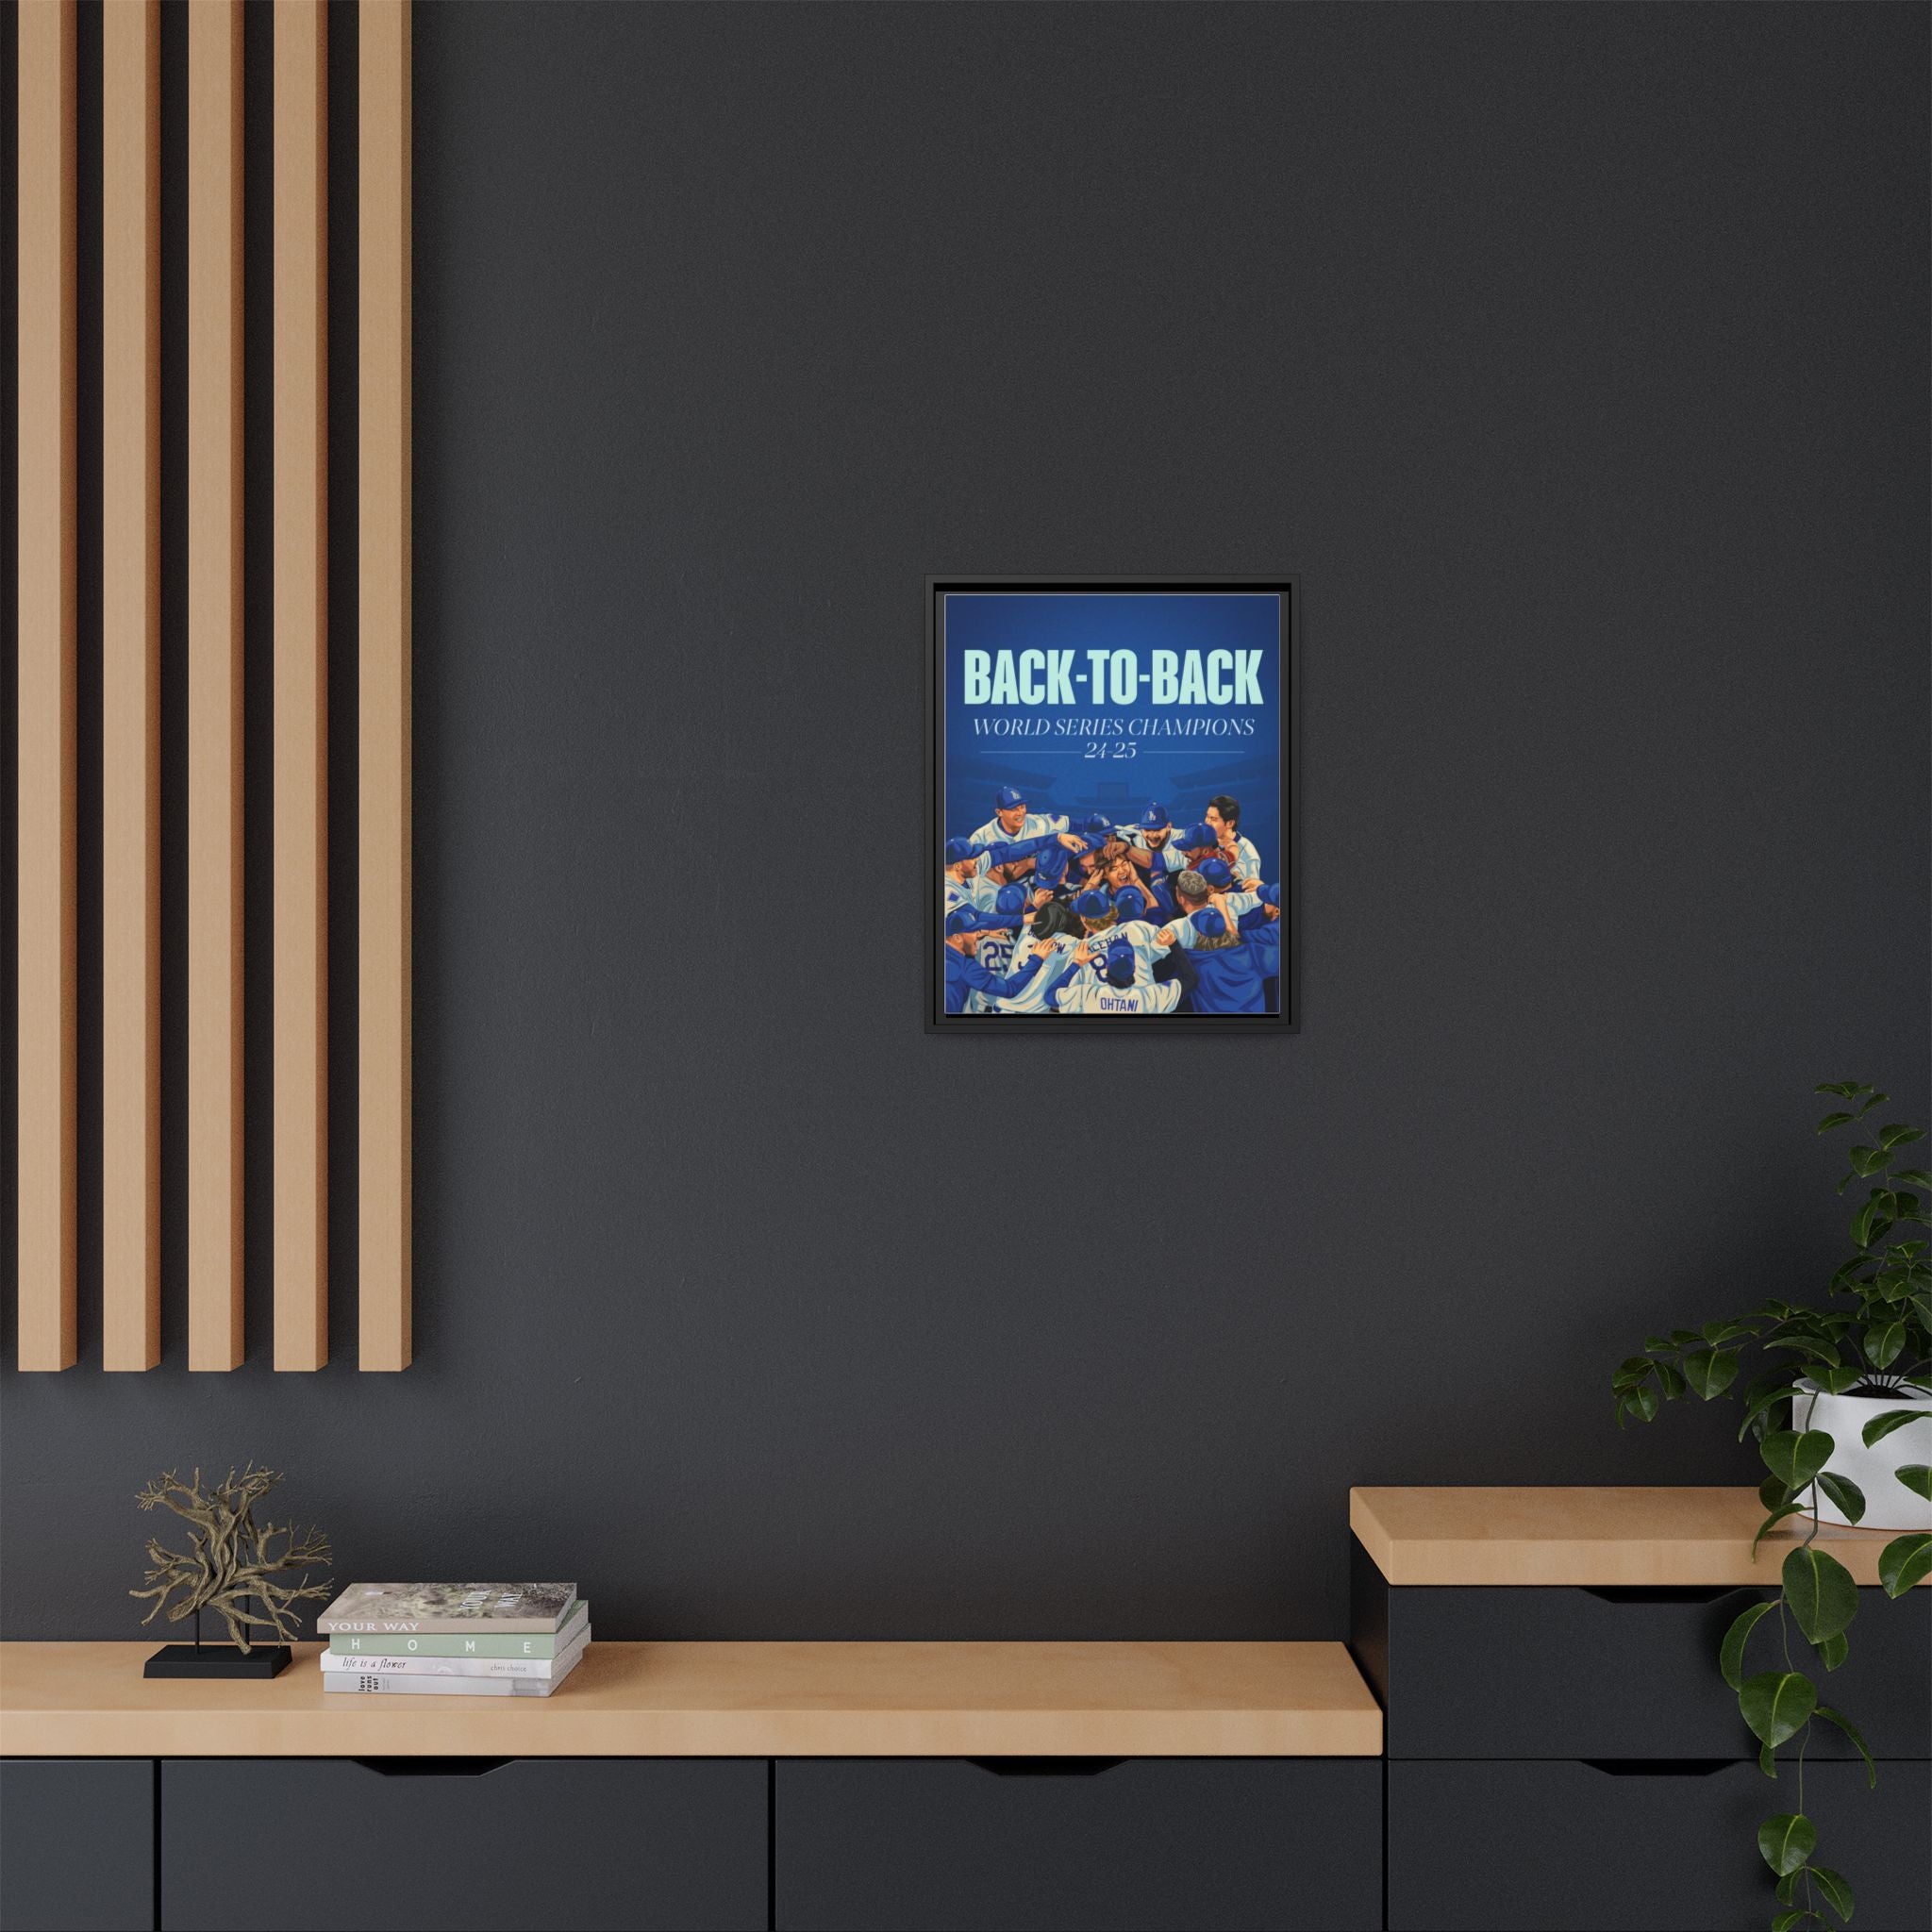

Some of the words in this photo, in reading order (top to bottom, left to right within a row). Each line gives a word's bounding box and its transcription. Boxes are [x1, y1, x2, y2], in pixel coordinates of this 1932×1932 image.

[963, 648, 1264, 706] BACK-TO-BACK
[974, 718, 1051, 736] WORLD
[1054, 718, 1124, 736] SERIES
[1128, 718, 1256, 736] CHAMPIONS
[983, 941, 1016, 973] 25
[1100, 997, 1139, 1012] OHTANI
[328, 1622, 377, 1631] YOUR
[383, 1622, 420, 1631] WAY
[351, 1638, 531, 1653] HOME
[342, 1657, 357, 1671] life
[359, 1658, 367, 1668] is
[377, 1657, 407, 1671] flower
[358, 1675, 366, 1691] love
